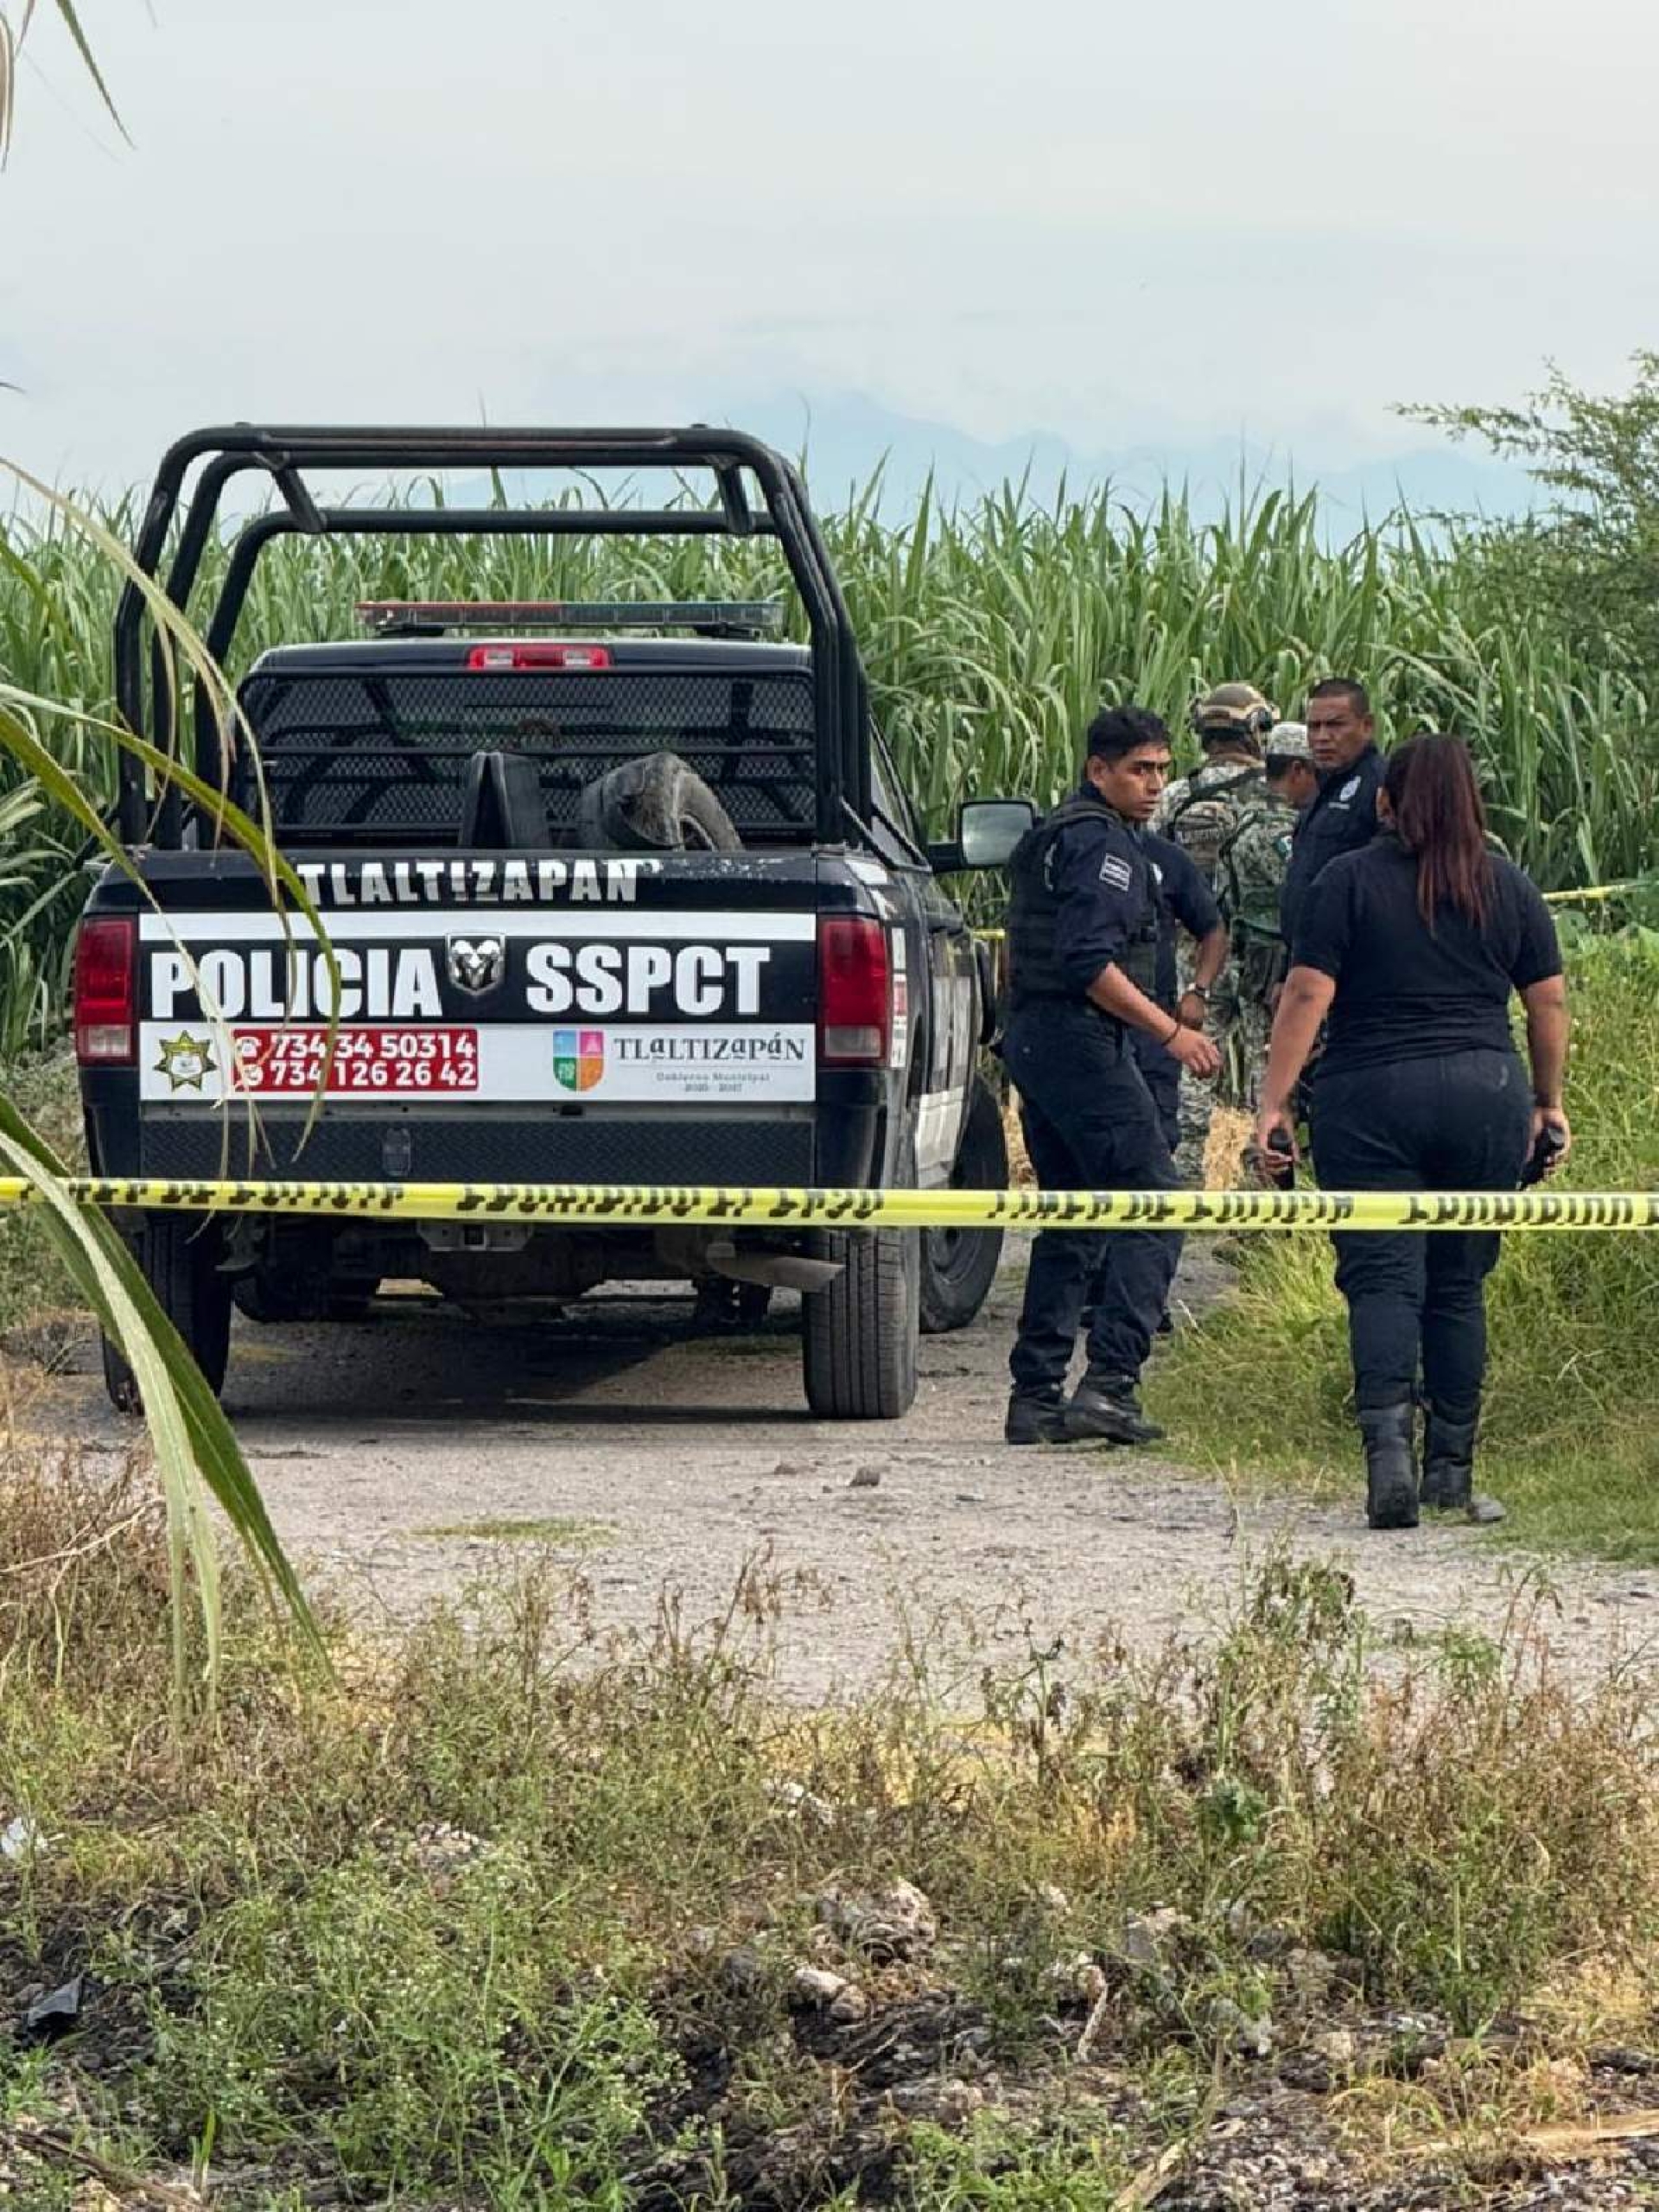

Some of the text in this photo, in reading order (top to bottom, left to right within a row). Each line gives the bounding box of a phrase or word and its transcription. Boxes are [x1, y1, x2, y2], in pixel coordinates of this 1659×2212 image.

[297, 860, 638, 906] TLALTIZAPAN
[151, 944, 771, 1020] POLICIA SSPCT
[270, 1033, 474, 1058] 734 34 50314
[270, 1061, 476, 1086] 734 126 26 42
